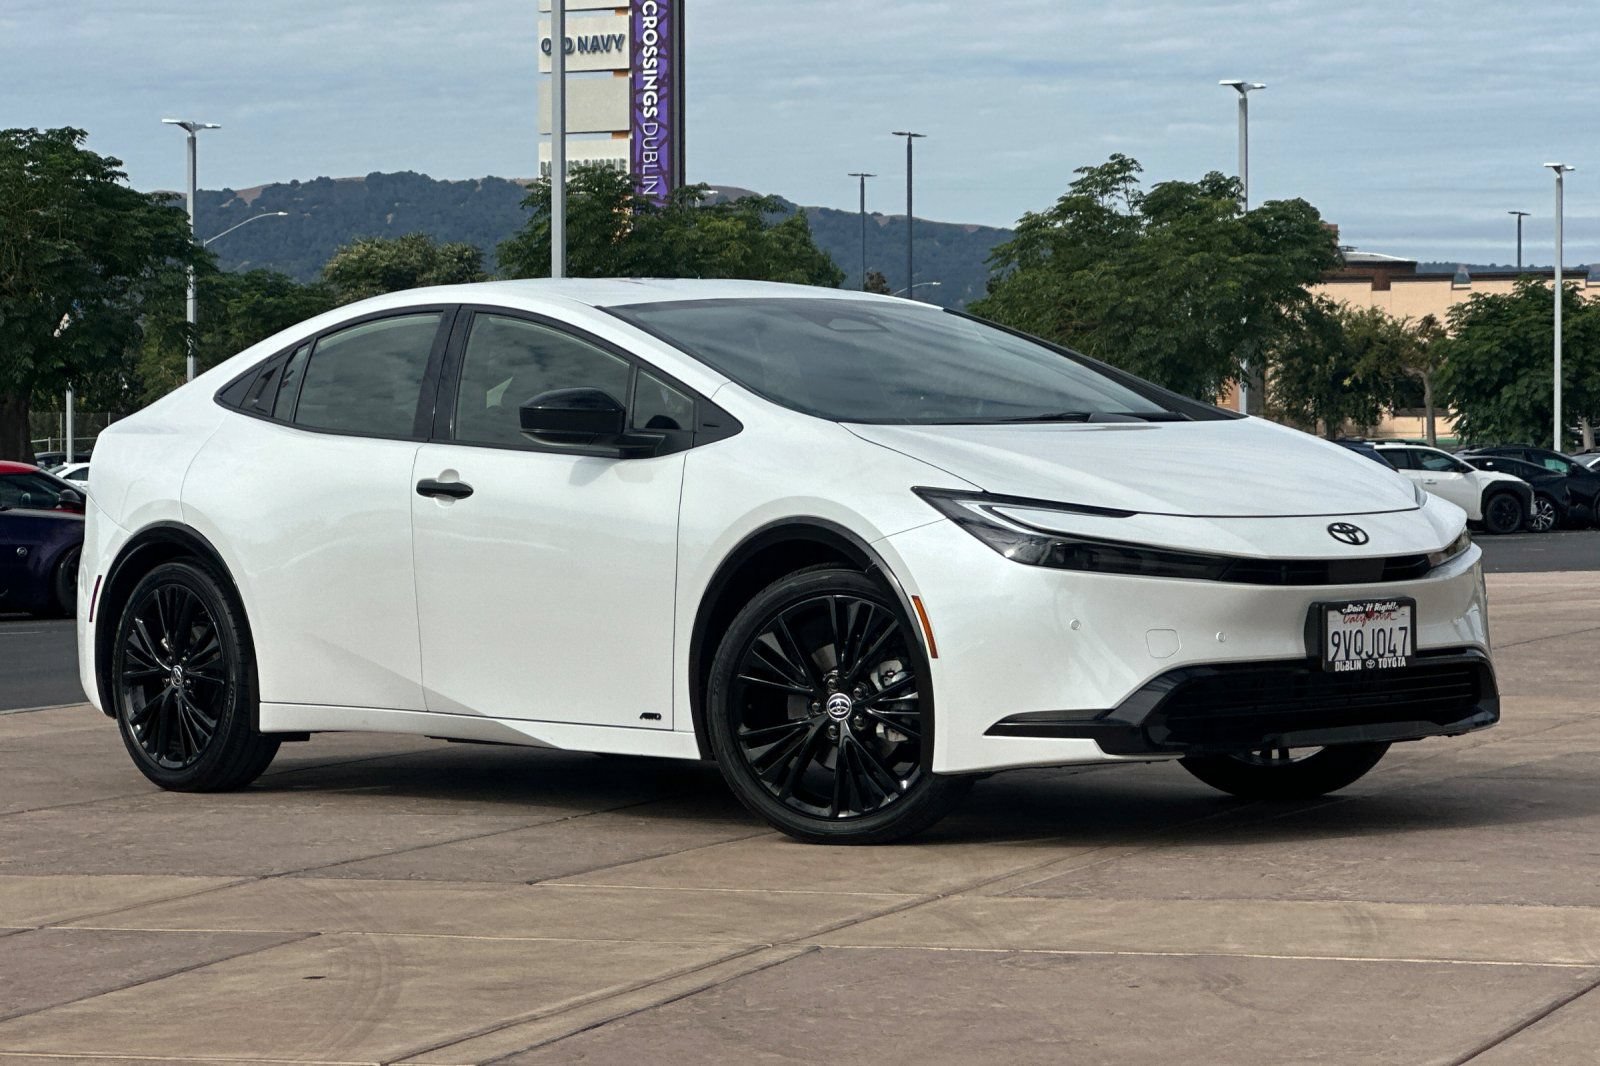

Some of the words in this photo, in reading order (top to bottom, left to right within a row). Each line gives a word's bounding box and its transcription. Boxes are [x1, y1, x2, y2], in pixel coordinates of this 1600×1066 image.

[541, 36, 573, 55] OD
[577, 34, 625, 54] NAVY
[642, 0, 658, 118] CROSSINGS
[642, 122, 658, 195] DUBLIN
[1331, 626, 1408, 661] 9VQJ047
[1335, 660, 1362, 671] DUBLIN
[1378, 657, 1406, 669] TOYOTA
